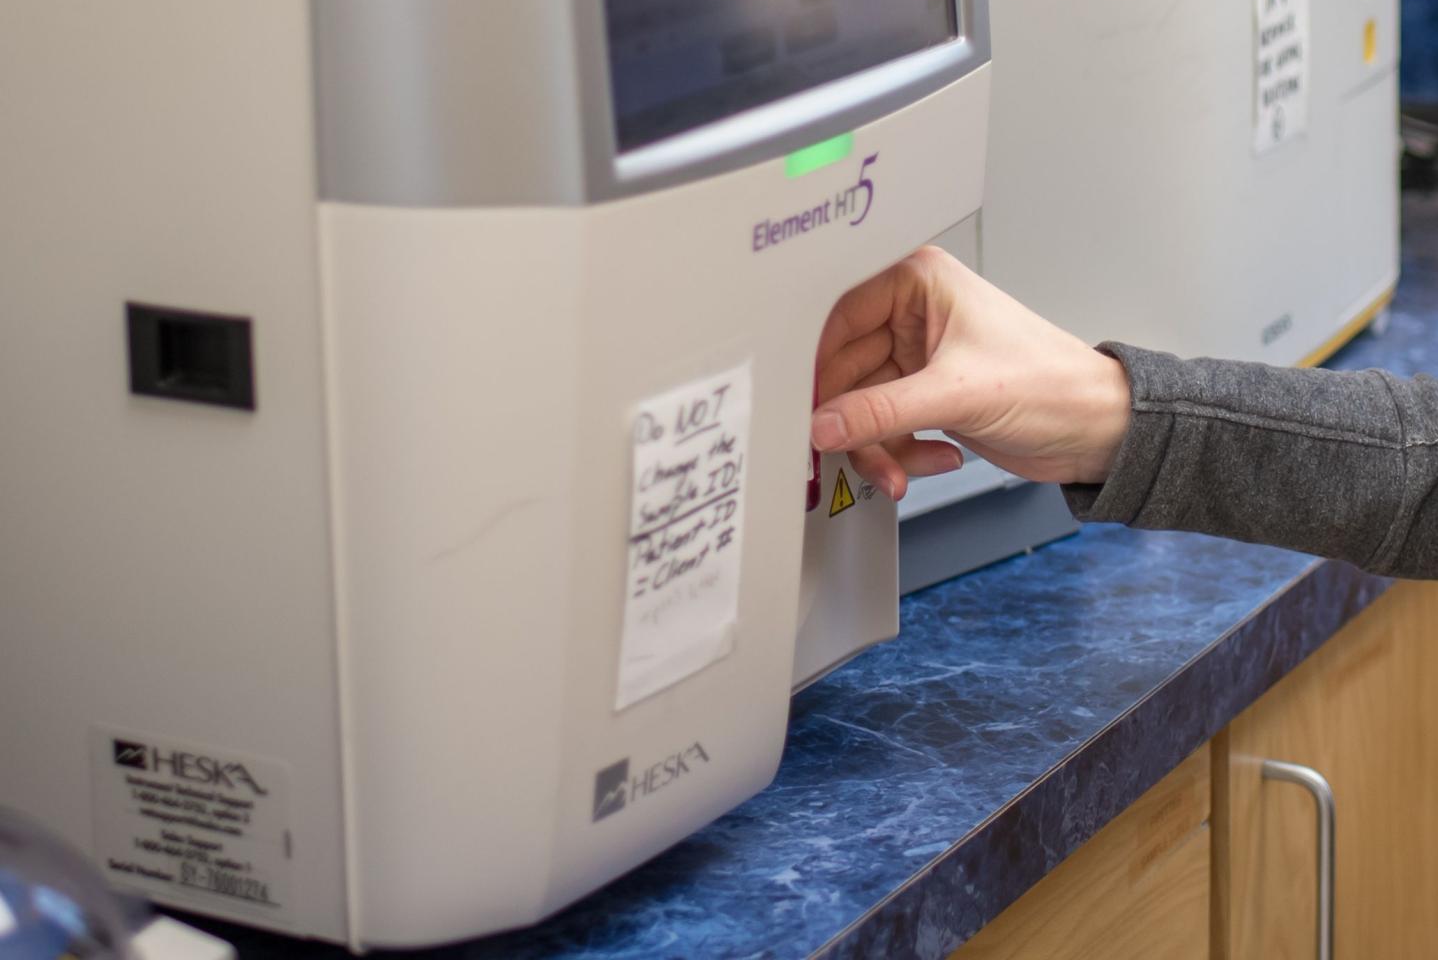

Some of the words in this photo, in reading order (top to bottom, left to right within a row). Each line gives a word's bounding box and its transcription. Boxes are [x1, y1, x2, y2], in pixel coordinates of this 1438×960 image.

[752, 199, 832, 252] Element
[674, 384, 731, 435] NOT
[708, 431, 736, 460] the
[709, 500, 737, 530] ID
[652, 544, 710, 590] Client
[153, 747, 268, 796] HESKA
[630, 741, 710, 802] HESKA
